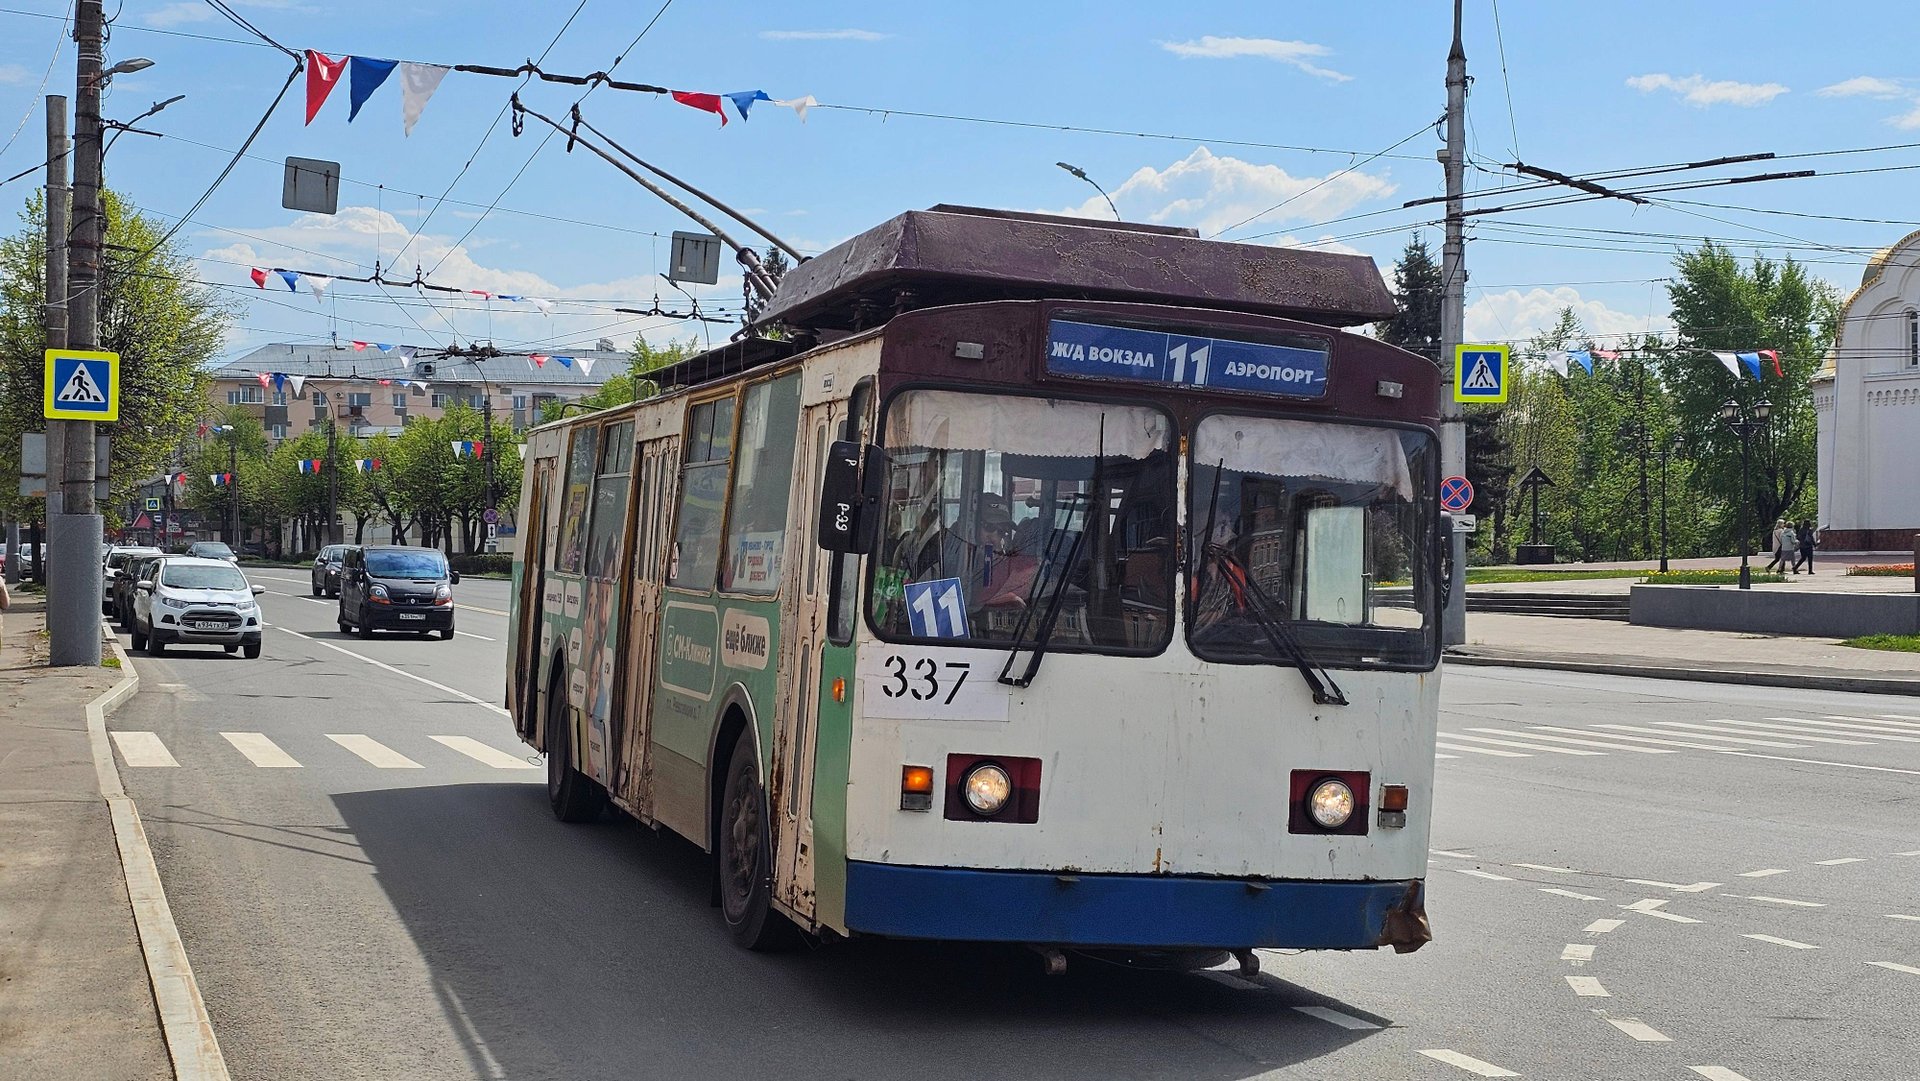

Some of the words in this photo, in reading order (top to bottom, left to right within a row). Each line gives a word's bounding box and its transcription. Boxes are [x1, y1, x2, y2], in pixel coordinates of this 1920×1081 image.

[1051, 342, 1085, 362] Ж/Д
[1088, 346, 1155, 369] ВОКЗАЛ
[1168, 342, 1211, 386] 11
[1225, 361, 1314, 385] АЭРОПОРТ
[912, 583, 965, 637] 11
[725, 623, 740, 655] ещё
[740, 625, 766, 657] ближе
[882, 655, 970, 705] 337
